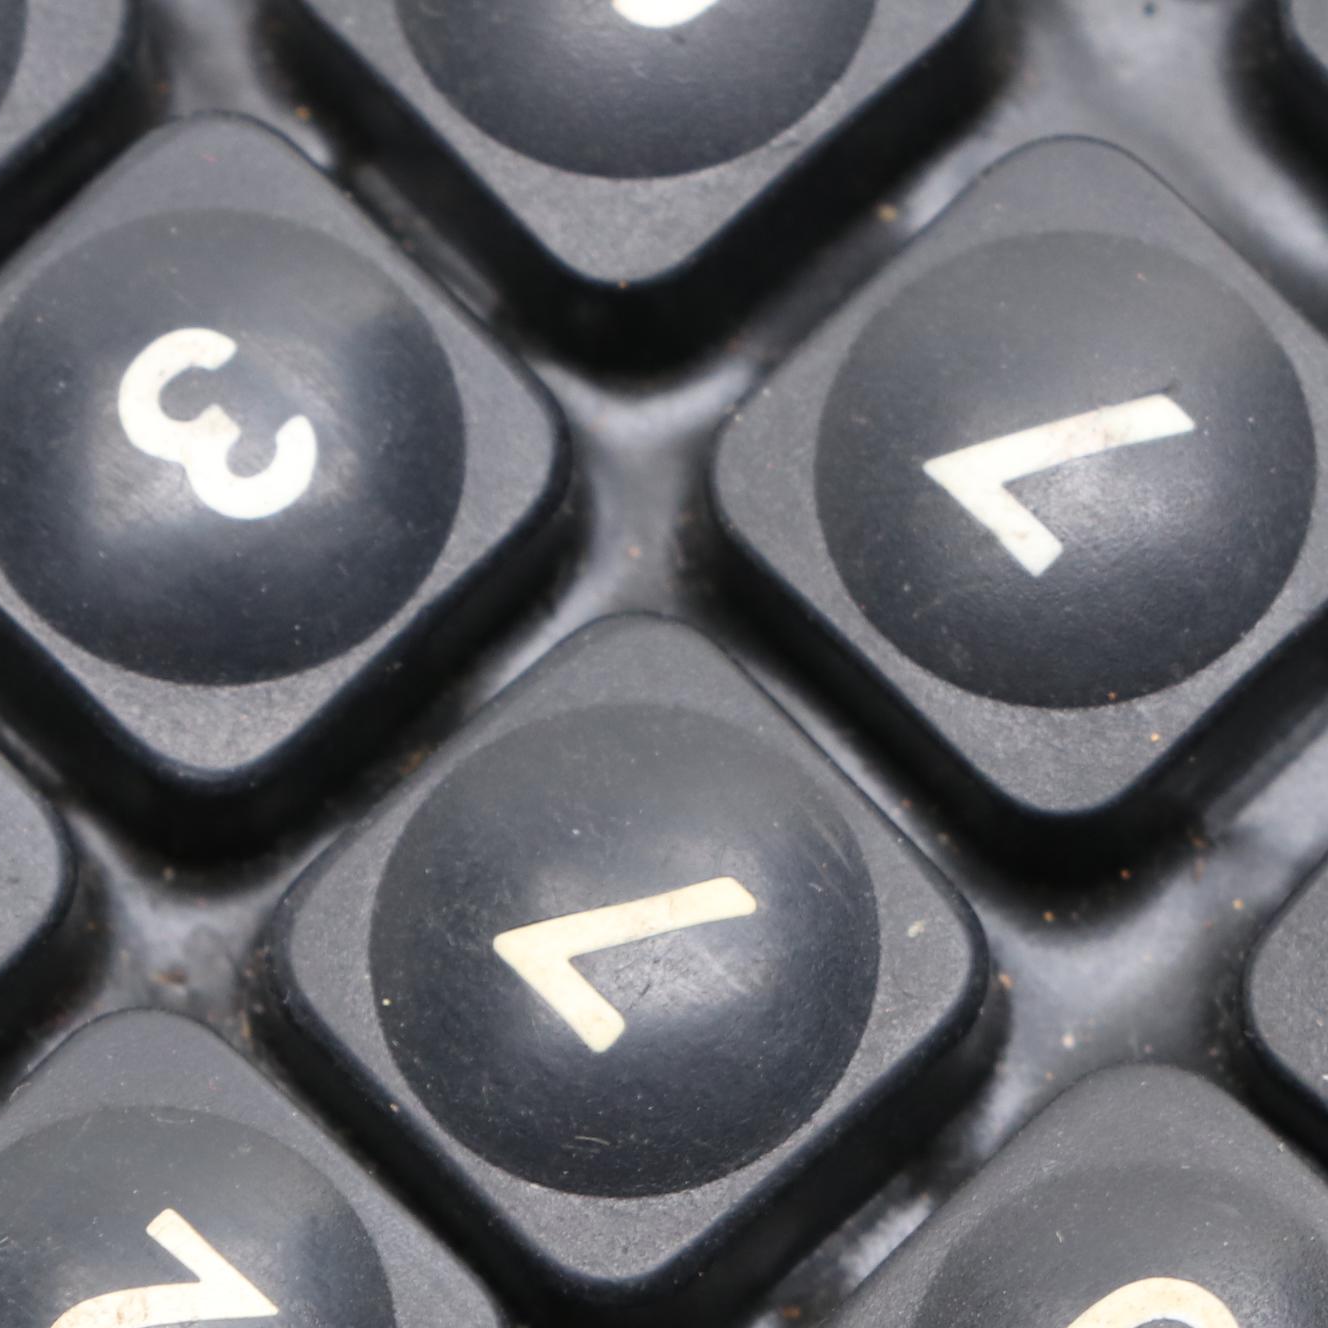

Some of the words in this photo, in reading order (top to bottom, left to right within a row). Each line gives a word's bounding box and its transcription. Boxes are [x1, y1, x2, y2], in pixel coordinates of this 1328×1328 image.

[116, 327, 319, 520] 3
[922, 392, 1196, 577] 7
[492, 875, 758, 1054] 7
